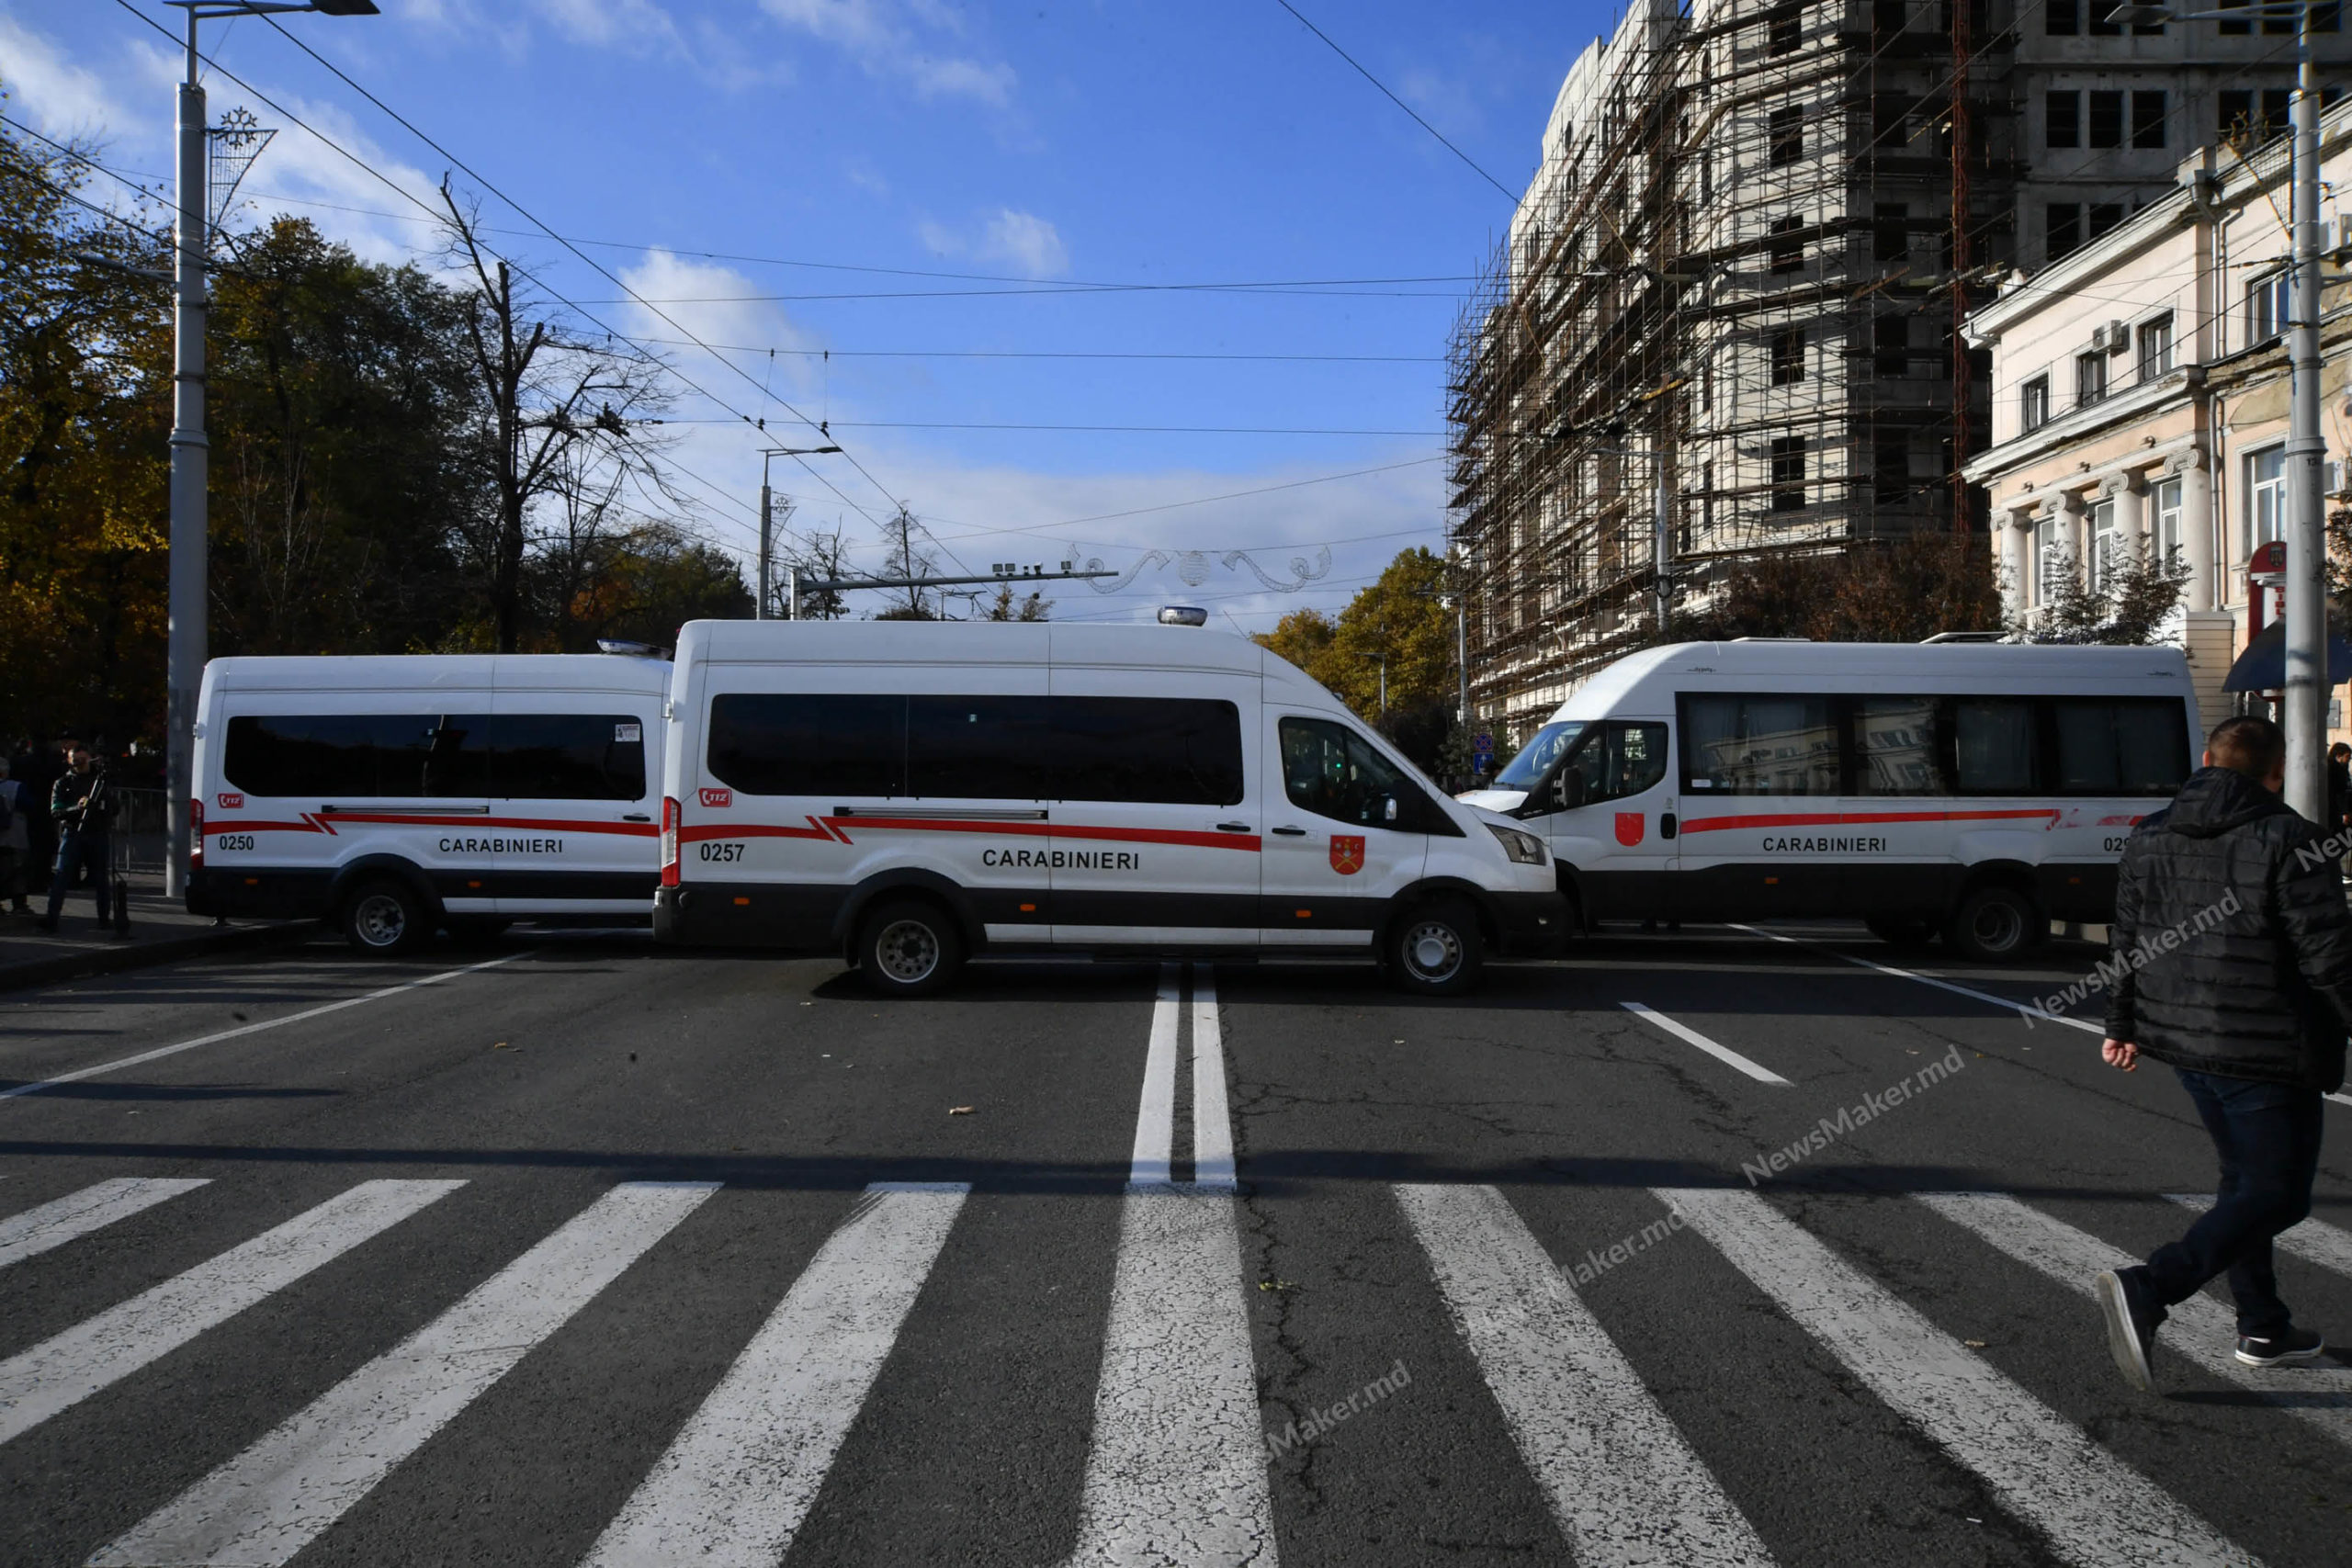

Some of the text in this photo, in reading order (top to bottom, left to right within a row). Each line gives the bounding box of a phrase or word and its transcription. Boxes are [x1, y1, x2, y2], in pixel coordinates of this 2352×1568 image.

[709, 793, 727, 802] 112
[219, 835, 254, 851] 0250
[439, 838, 562, 853] CARABINIERI
[1762, 837, 1886, 852] CARABINIERI
[700, 843, 745, 862] 0257
[982, 849, 1139, 870] CARABINIERI
